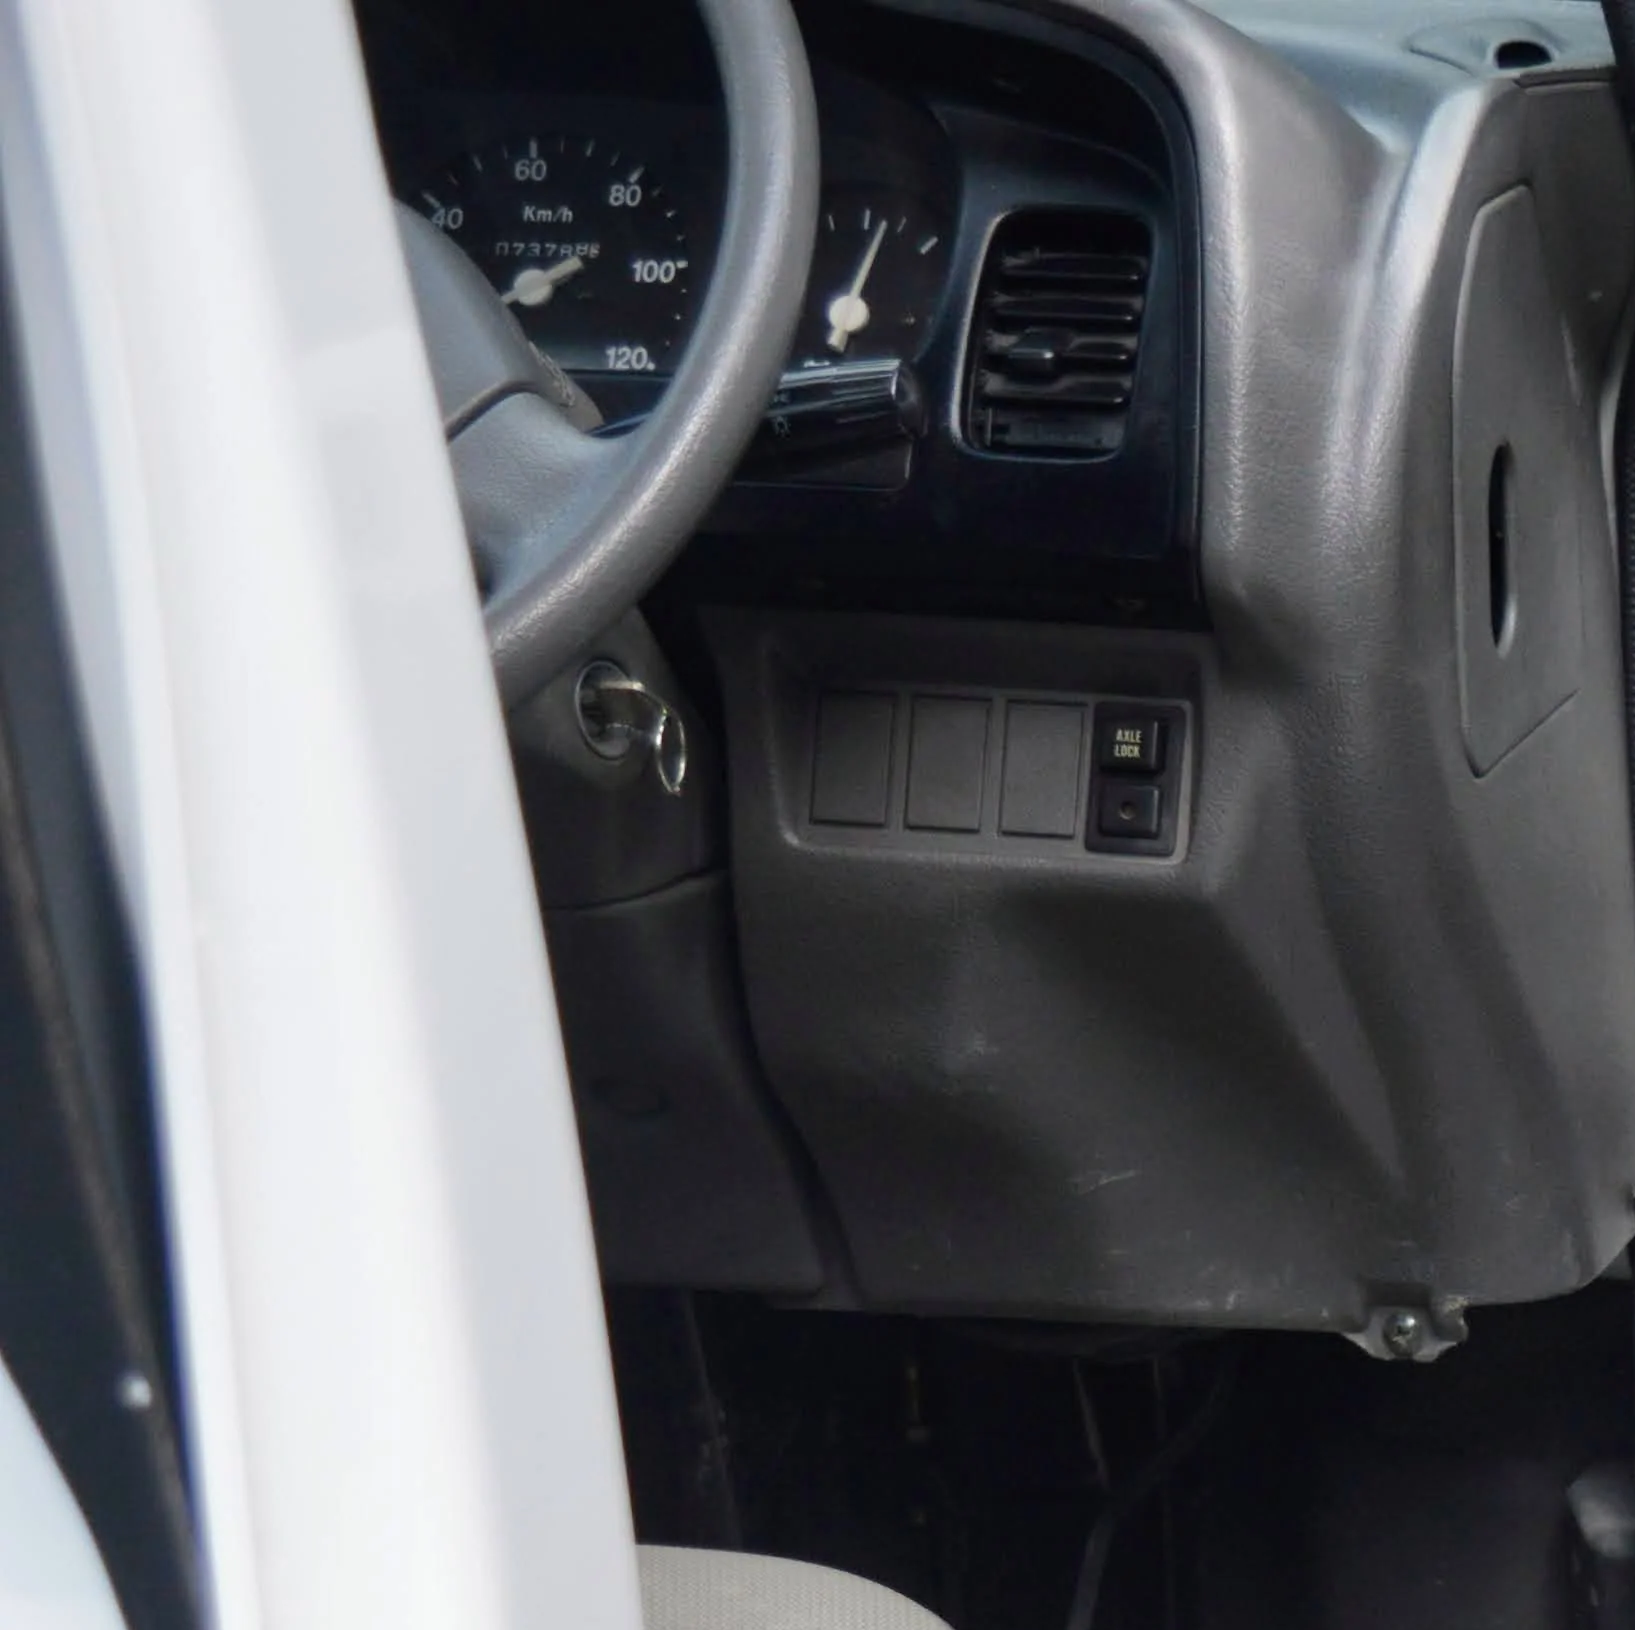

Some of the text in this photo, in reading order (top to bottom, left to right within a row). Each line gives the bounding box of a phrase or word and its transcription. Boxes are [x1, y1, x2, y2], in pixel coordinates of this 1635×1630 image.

[514, 161, 547, 182] 60
[609, 185, 642, 207] 80
[431, 209, 463, 230] 40
[523, 205, 573, 226] Km/h
[632, 260, 675, 284] 100
[605, 346, 649, 371] 120
[1116, 729, 1142, 742] AXLE
[1115, 744, 1141, 758] LOCK
